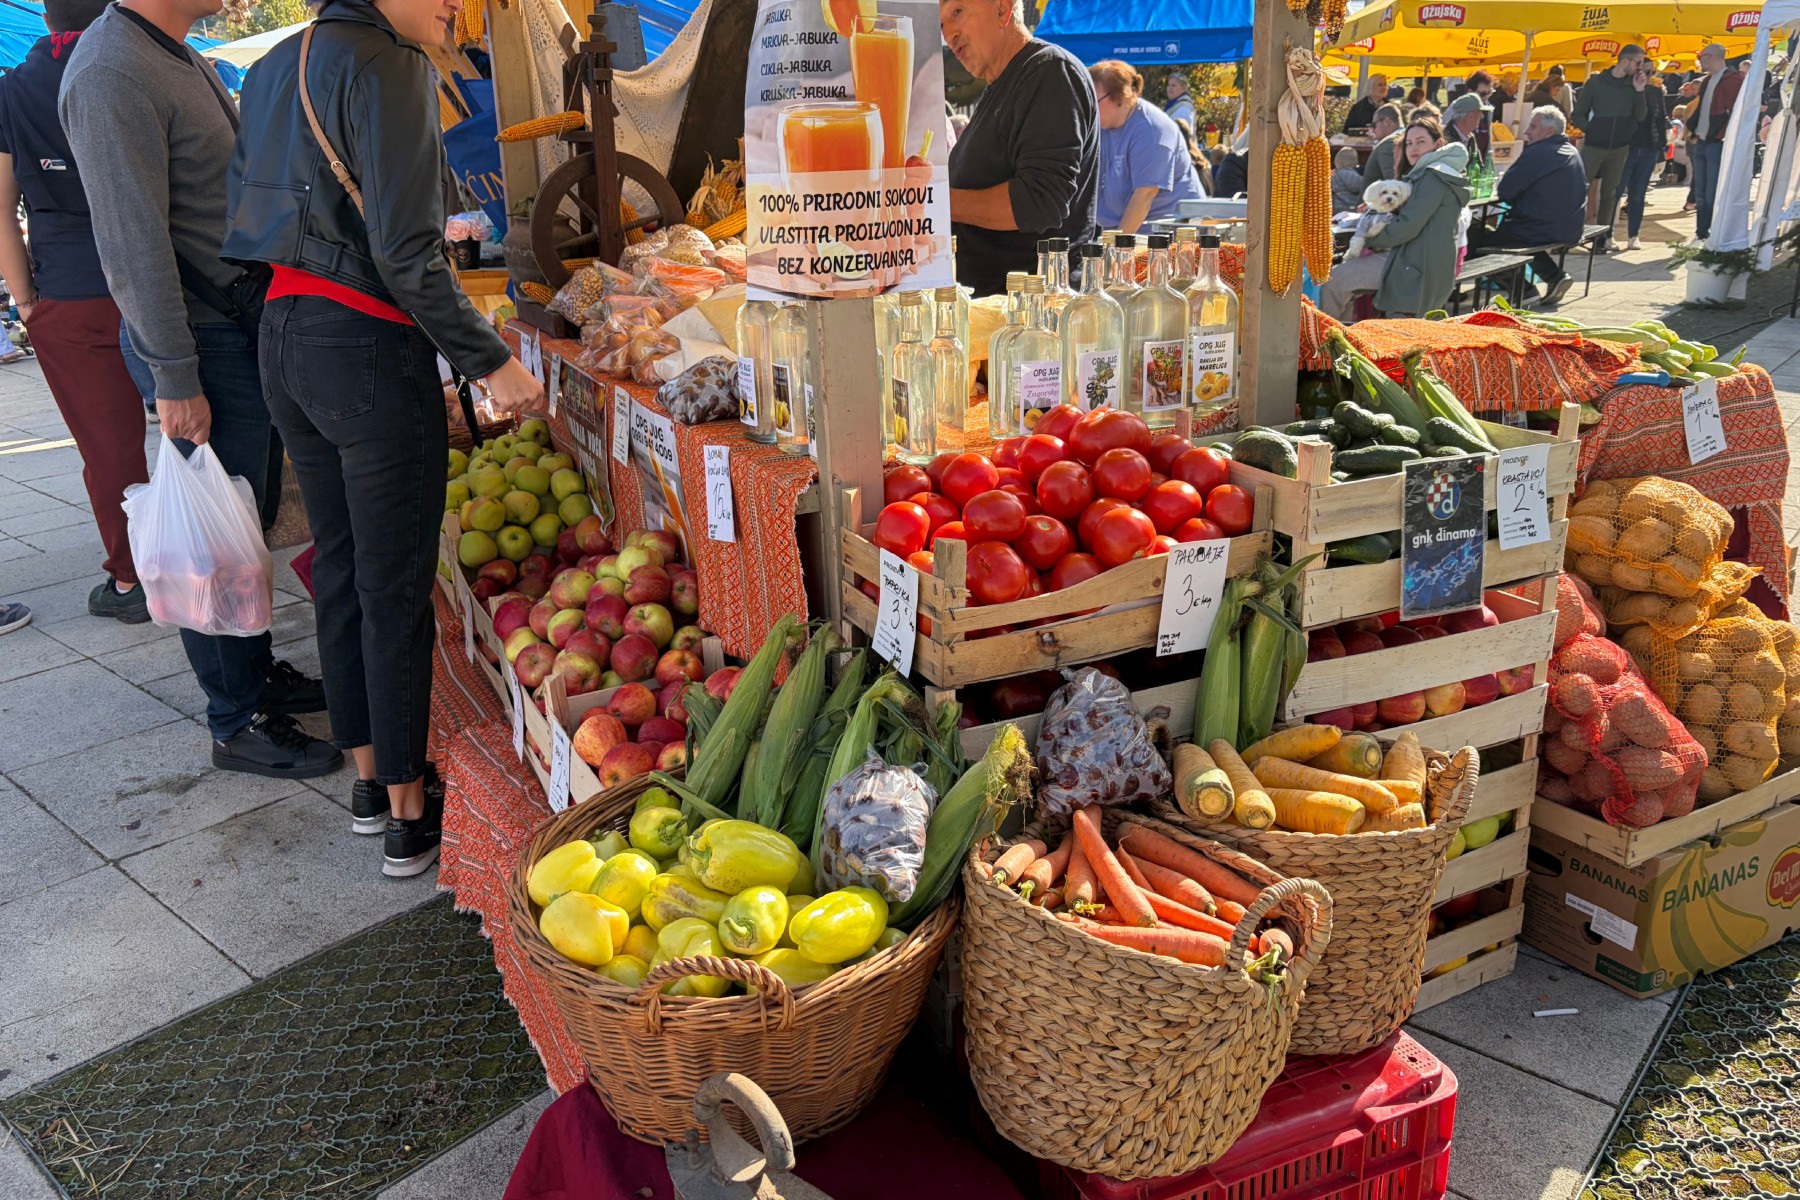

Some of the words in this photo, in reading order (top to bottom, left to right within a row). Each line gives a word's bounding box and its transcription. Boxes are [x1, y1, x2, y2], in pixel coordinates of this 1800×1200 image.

[764, 8, 792, 26] JABUKA
[1422, 5, 1462, 20] Ožujsko
[1582, 6, 1609, 21] ŽUJA
[1731, 12, 1760, 27] Ožujs
[761, 32, 839, 49] MRKVA-JABUKA
[761, 60, 832, 76] CIKLA-JABUKA
[761, 85, 847, 102] KRUŠKA-JABUKA
[759, 194, 799, 213] 100%
[803, 191, 881, 212] PRIRODNI
[885, 187, 934, 207] SOKOVI
[760, 224, 831, 245] VLASTITA
[835, 217, 934, 243] PROIZVODNJA
[778, 256, 805, 275] BEZ
[810, 248, 916, 275] KONZERVANSA
[1199, 341, 1212, 350] OPG
[1214, 340, 1226, 349] JUG
[1033, 368, 1047, 377] OPG
[1048, 367, 1060, 376] JUG
[1199, 362, 1228, 371] MARELICE
[635, 414, 648, 433] OPG
[649, 421, 664, 442] JUG
[1502, 468, 1545, 485] KRASTAVCI
[1513, 483, 1530, 513] 2
[1412, 529, 1433, 549] gnk
[1436, 527, 1476, 542] dinamo
[883, 574, 911, 604] PAPRIKA
[1176, 574, 1194, 616] 3
[890, 599, 901, 630] 3
[1570, 858, 1650, 904] BANANAS
[1662, 855, 1760, 913] BANANAS
[1772, 867, 1790, 889] Del
